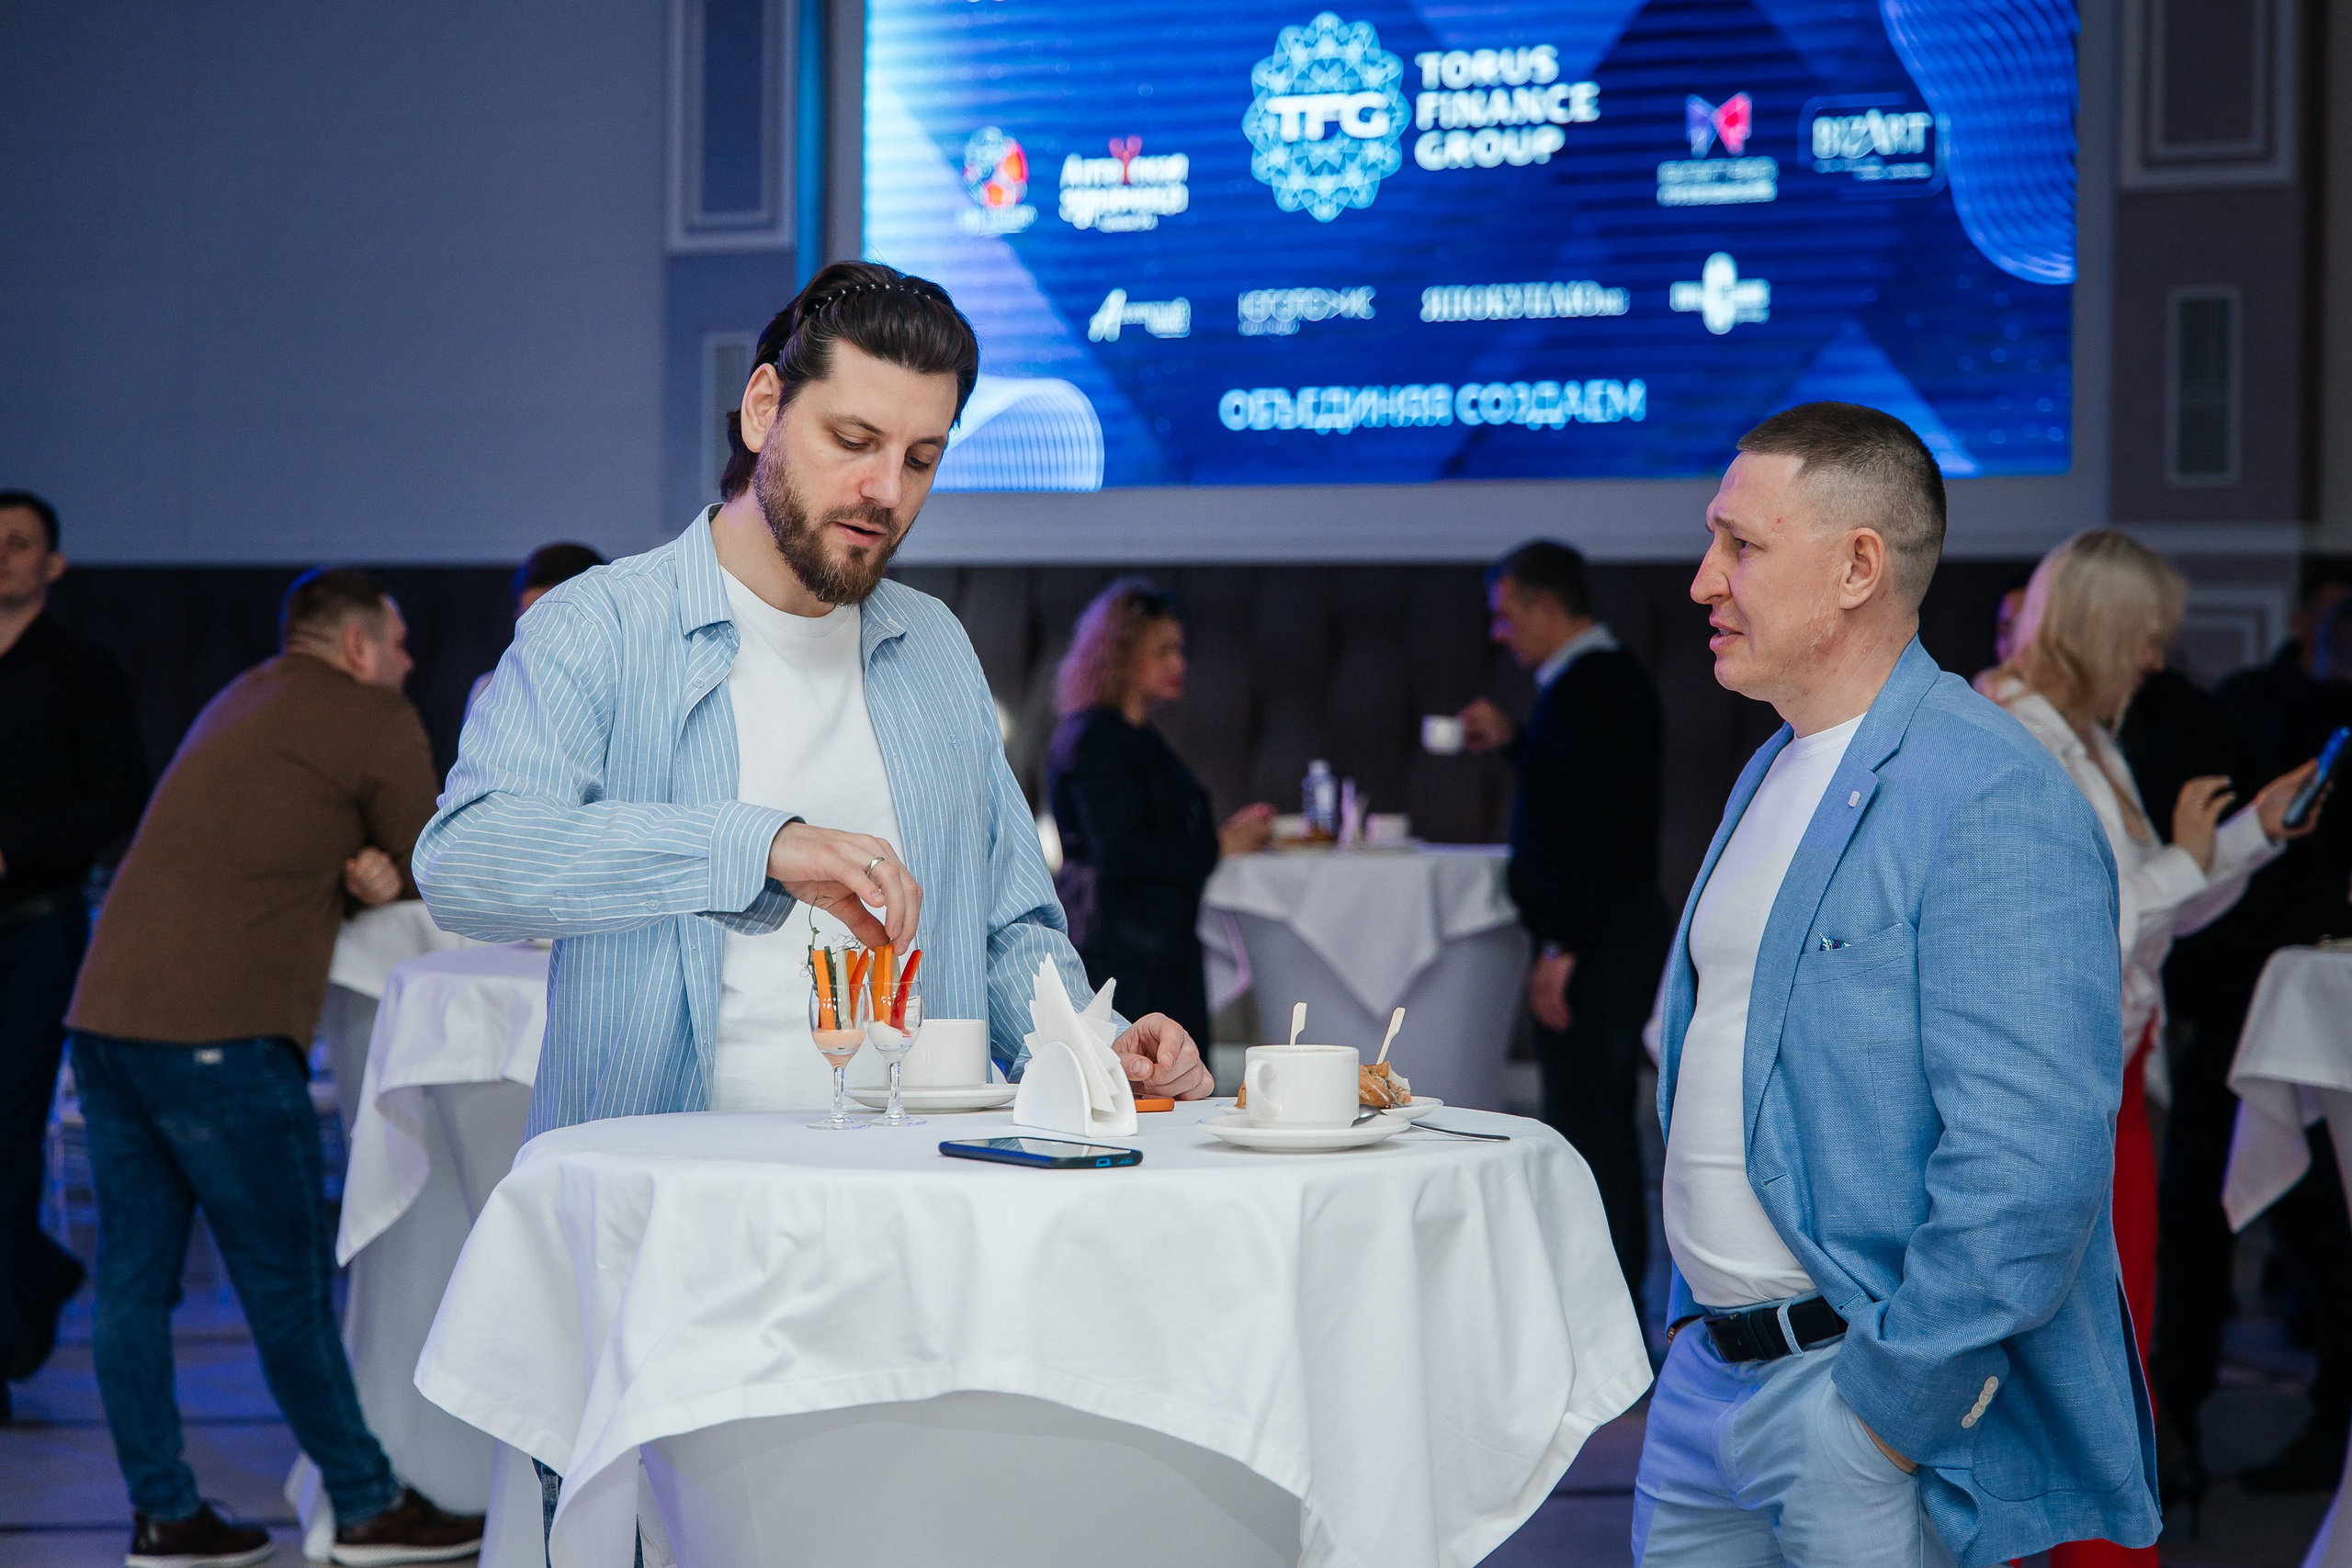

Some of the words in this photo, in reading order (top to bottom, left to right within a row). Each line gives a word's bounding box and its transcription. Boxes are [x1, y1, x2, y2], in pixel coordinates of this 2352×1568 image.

[1415, 43, 1560, 90] TORUS
[1266, 92, 1391, 142] TFG
[1416, 81, 1600, 130] FINANCE
[1414, 125, 1566, 172] GROUP
[1218, 383, 1454, 435] ОБЪЕДИНЯЯ
[1454, 378, 1646, 431] СОЗДАЕМ
